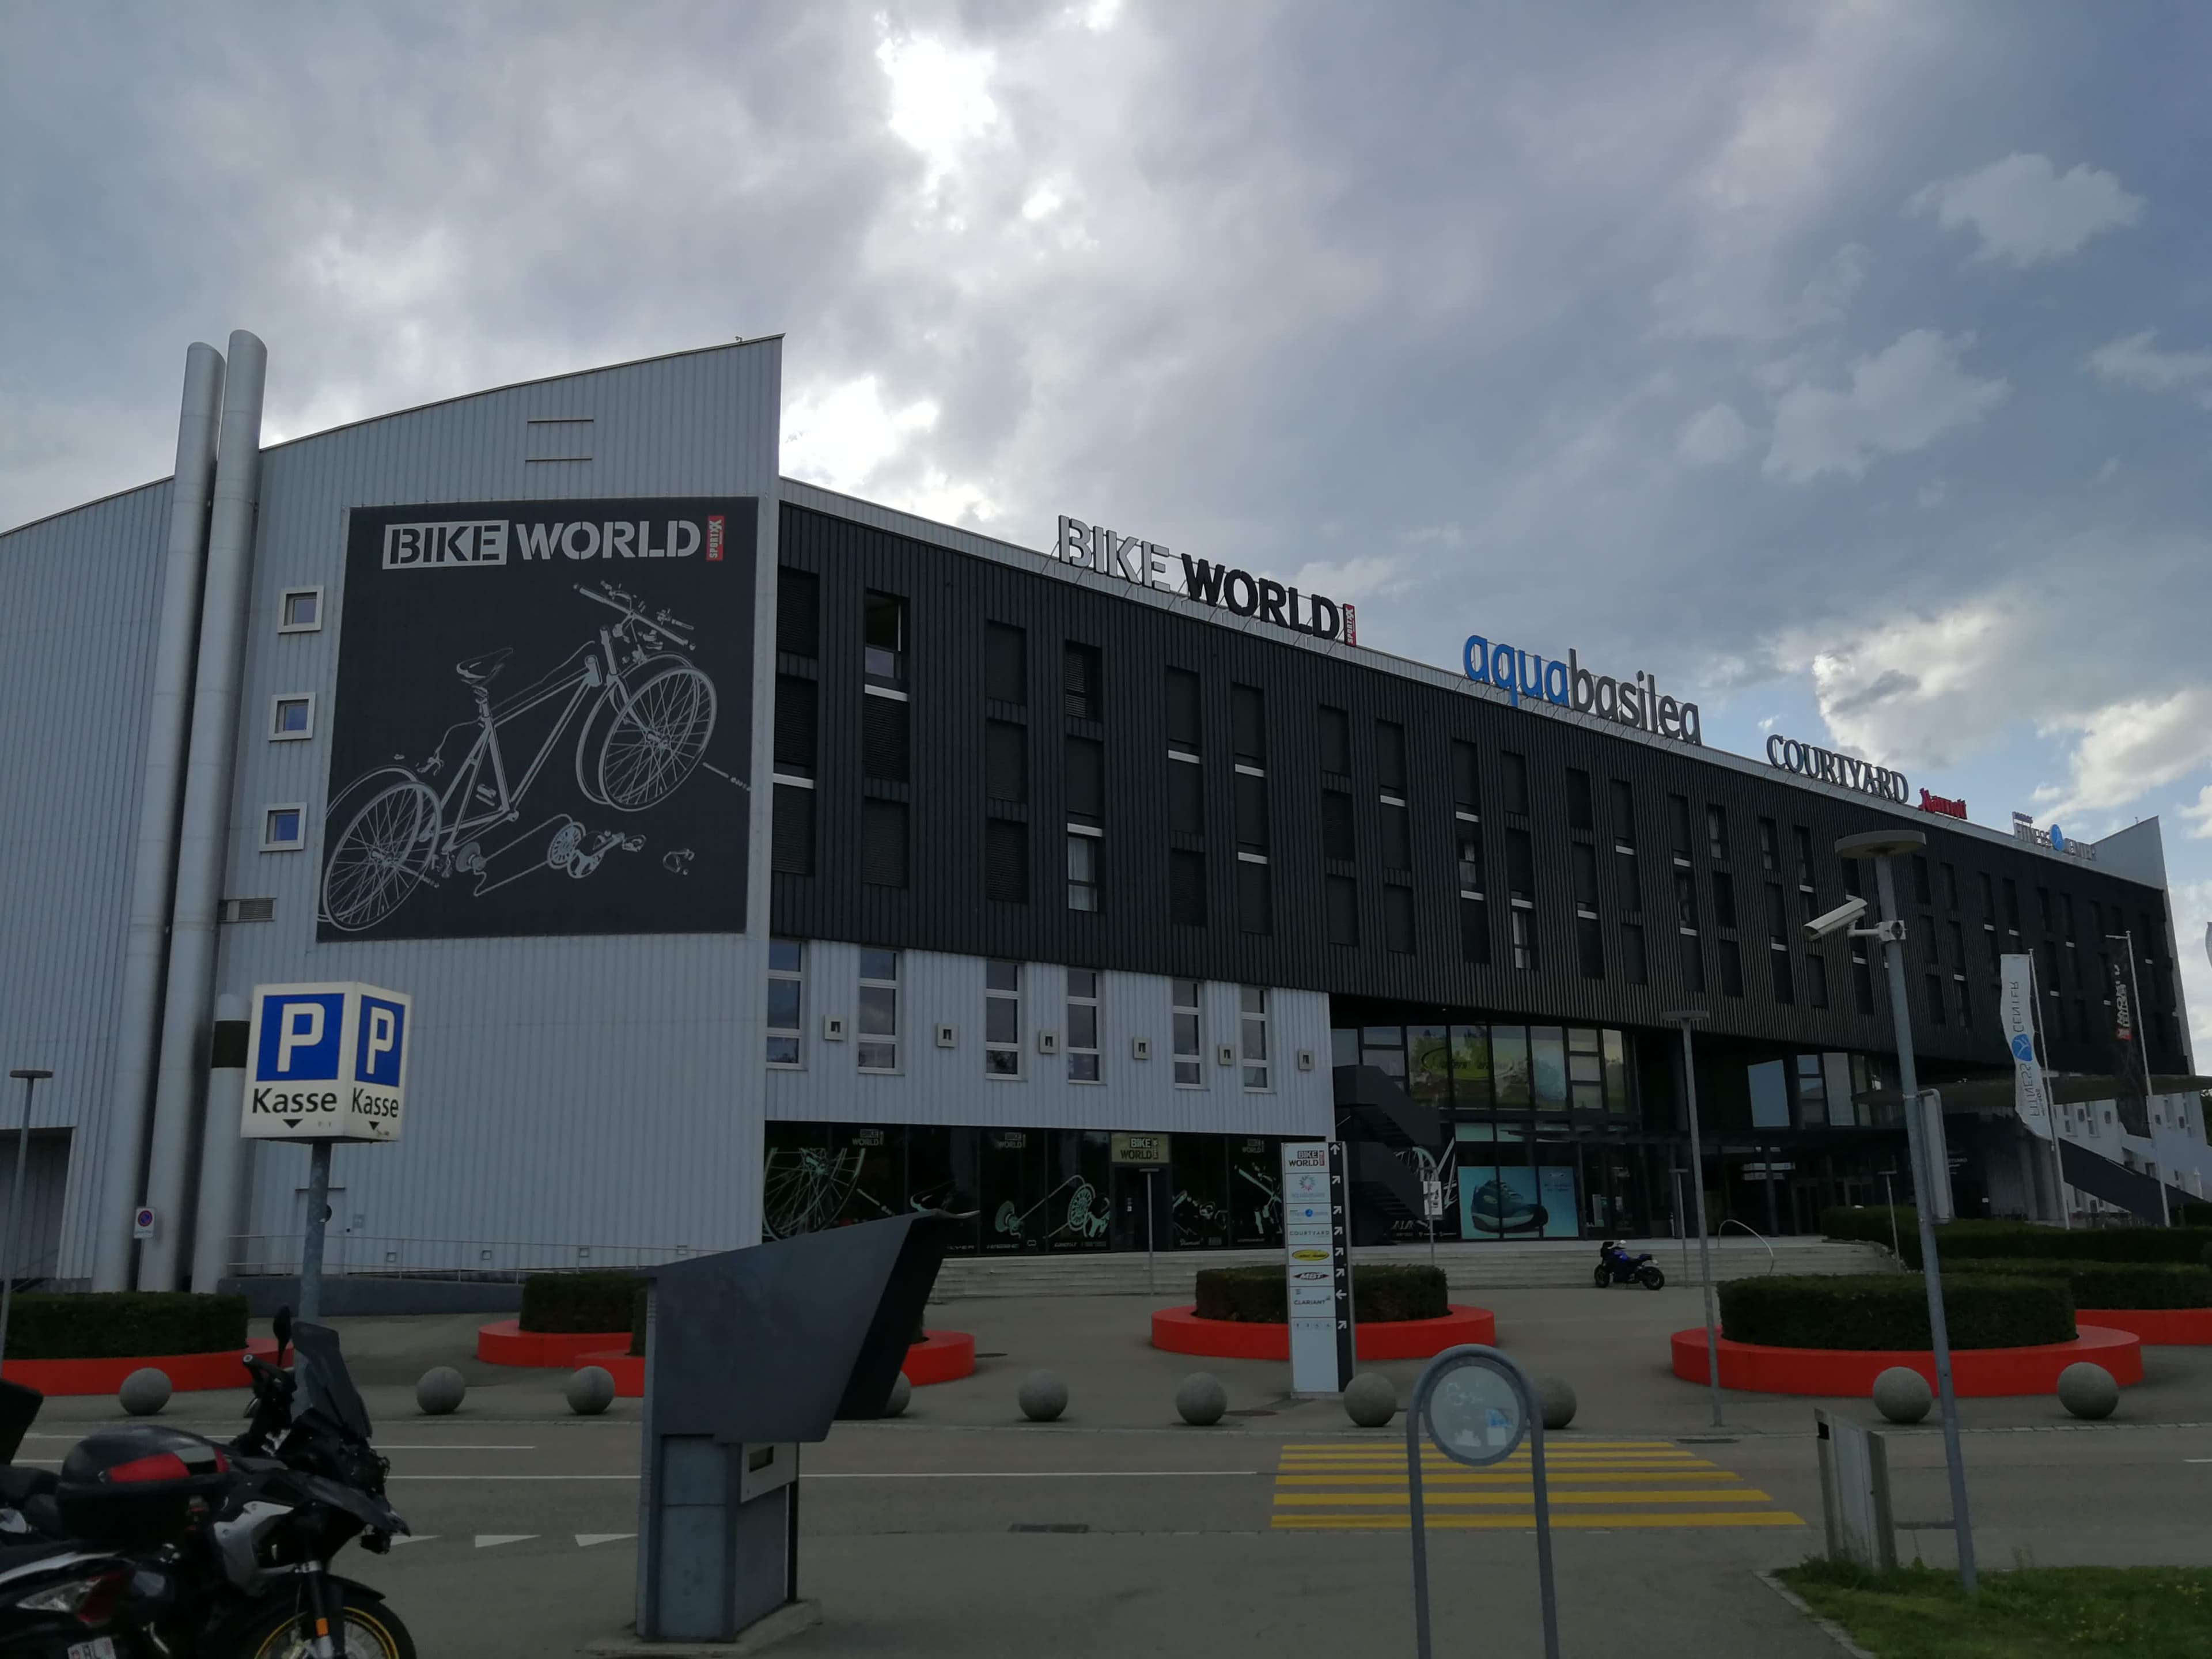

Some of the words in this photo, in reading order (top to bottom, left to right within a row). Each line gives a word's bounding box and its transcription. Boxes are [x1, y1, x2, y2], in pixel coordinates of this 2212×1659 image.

[389, 524, 502, 565] BIKE
[516, 520, 700, 560] WORLD
[1058, 515, 1171, 593] BIKE
[1181, 553, 1340, 639] WORLD
[1463, 635, 1702, 745] aquabasilea
[1766, 734, 1908, 804] COURTYARD
[277, 1002, 325, 1072] P
[366, 1006, 395, 1074] P
[252, 1088, 338, 1113] Kasse
[351, 1087, 399, 1118] Kasse
[1120, 1150, 1152, 1160] WORLD
[1130, 1138, 1152, 1148] BIKE
